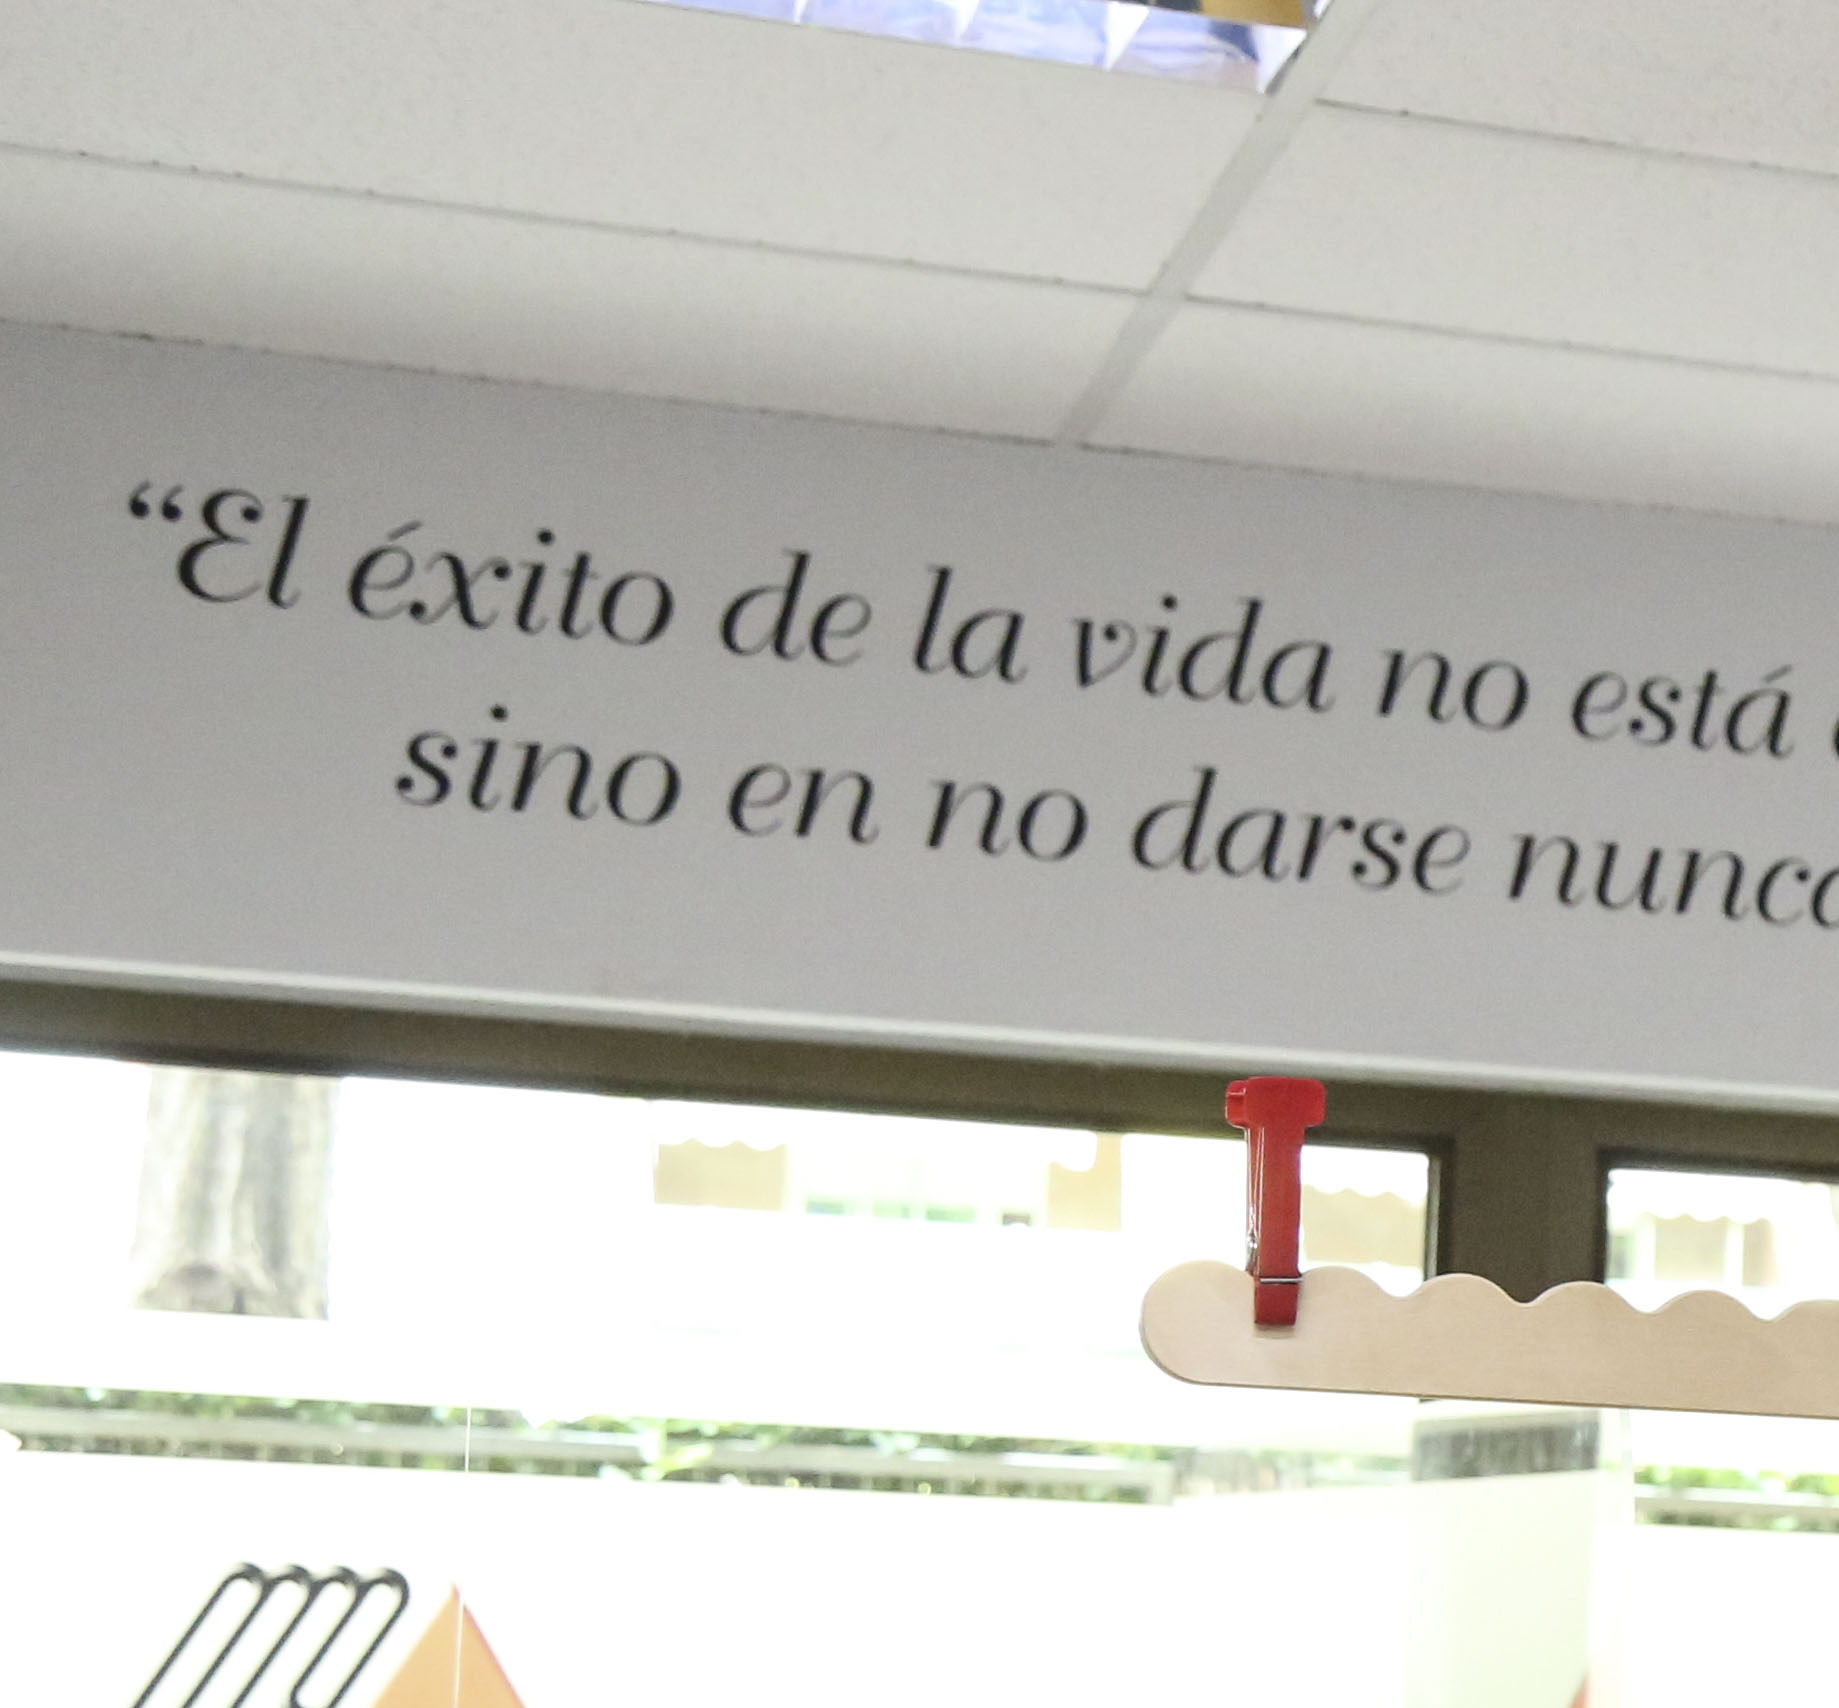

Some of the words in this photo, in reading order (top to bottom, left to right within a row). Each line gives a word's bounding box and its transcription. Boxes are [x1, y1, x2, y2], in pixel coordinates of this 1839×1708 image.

[128, 481, 310, 609] “El
[347, 522, 674, 646] éxito
[719, 551, 871, 665] de
[913, 566, 1024, 684] la
[1075, 594, 1332, 713] vida
[1377, 650, 1529, 730] no
[1570, 666, 1791, 759] está
[395, 704, 681, 826] sino
[727, 764, 878, 845] en
[926, 780, 1088, 861] no
[1130, 766, 1470, 894] darse
